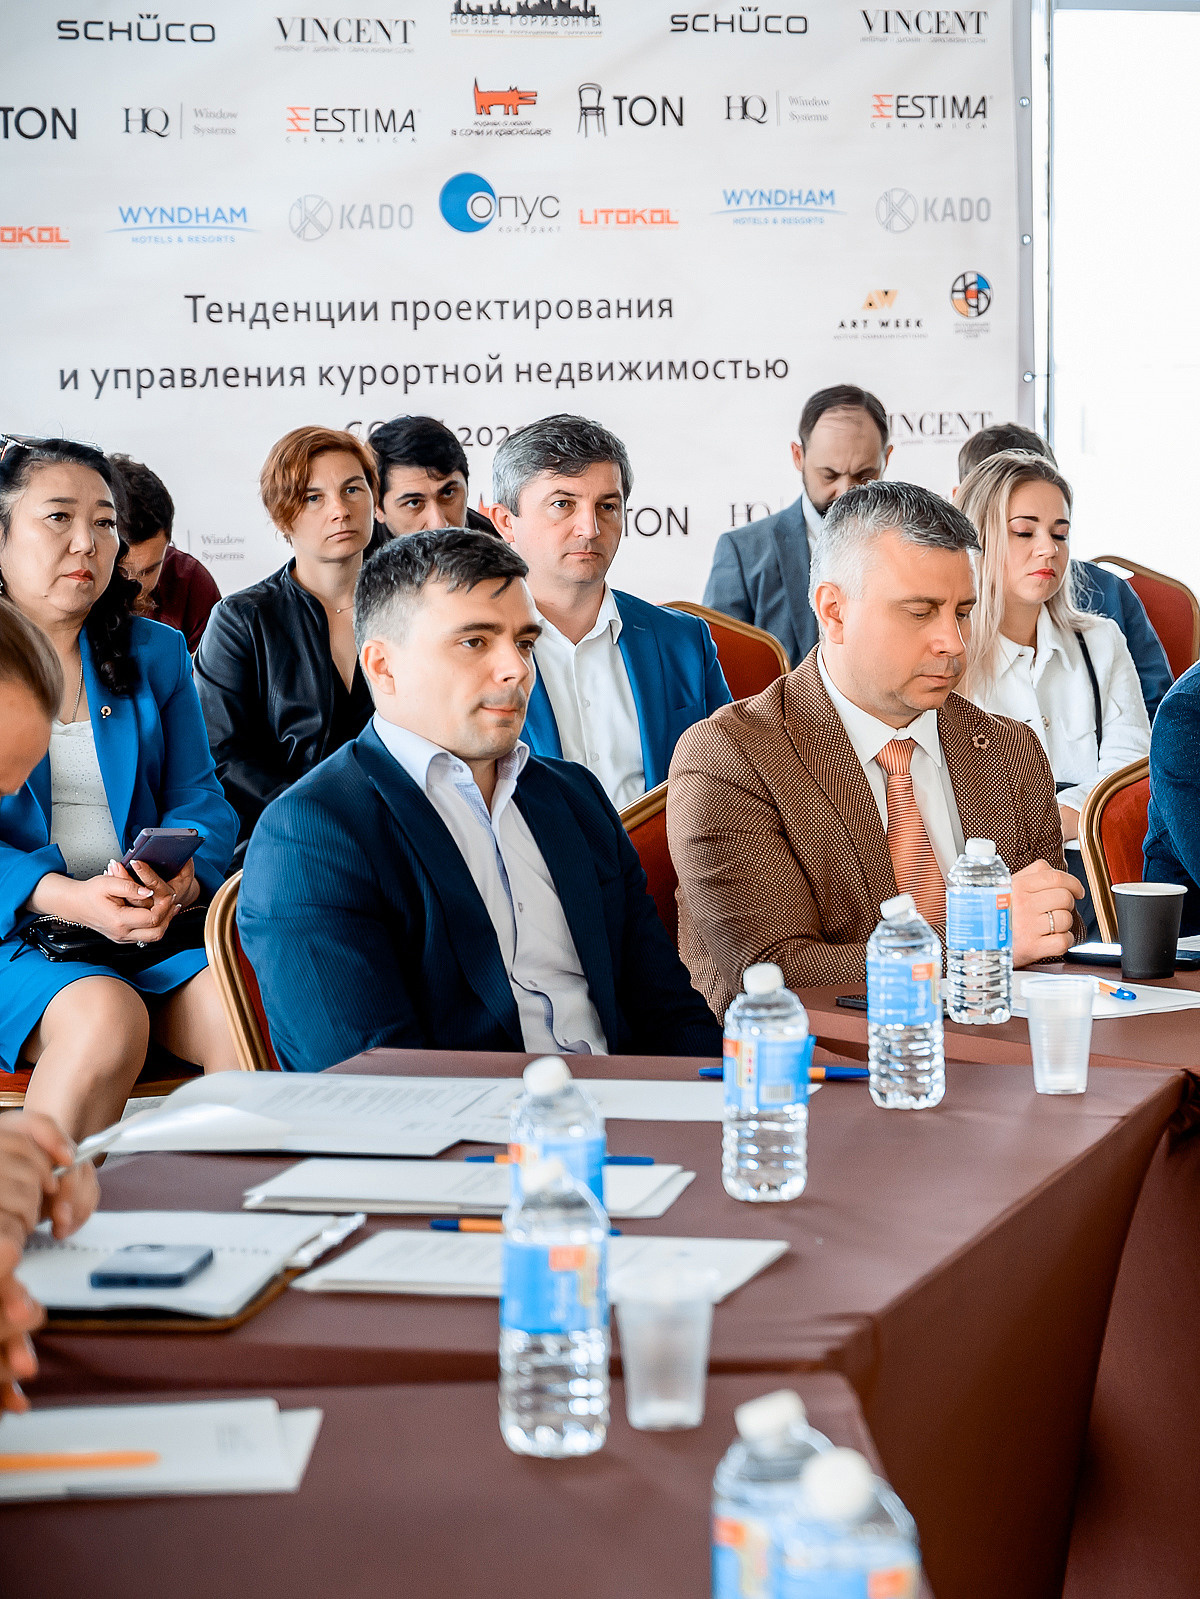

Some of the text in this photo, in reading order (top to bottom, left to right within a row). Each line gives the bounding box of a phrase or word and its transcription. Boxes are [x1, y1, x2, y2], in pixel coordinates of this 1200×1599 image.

[57, 14, 215, 43] SCHÜCO
[275, 17, 416, 44] VINCENT
[670, 6, 808, 34] SCHÜCO
[860, 9, 988, 34] VINCENT
[193, 107, 238, 119] Window
[612, 95, 684, 127] TON
[724, 95, 768, 124] HQ
[788, 96, 830, 107] Window
[896, 95, 987, 119] ESTIMA
[122, 106, 169, 138] HQ
[314, 108, 416, 132] ESTIMA
[788, 111, 829, 123] Systems
[193, 124, 236, 136] Systems
[722, 189, 836, 206] WYNDHAM
[923, 196, 992, 223] KADO
[118, 206, 247, 224] WYNDHAM
[338, 202, 414, 230] KADO
[579, 208, 679, 225] LITOKOL
[732, 217, 769, 225] HOTELS
[781, 217, 825, 225] RESORTS
[131, 236, 173, 244] HOTELS
[187, 235, 236, 243] RESORTS
[184, 295, 673, 331] Тенденции проектирования
[838, 319, 923, 329] ART WEEK
[59, 354, 789, 399] и управления курортной недвижимостью
[886, 411, 992, 436] INCENT
[457, 426, 524, 447] 202
[201, 533, 245, 544] Window
[202, 550, 245, 562] Systems
